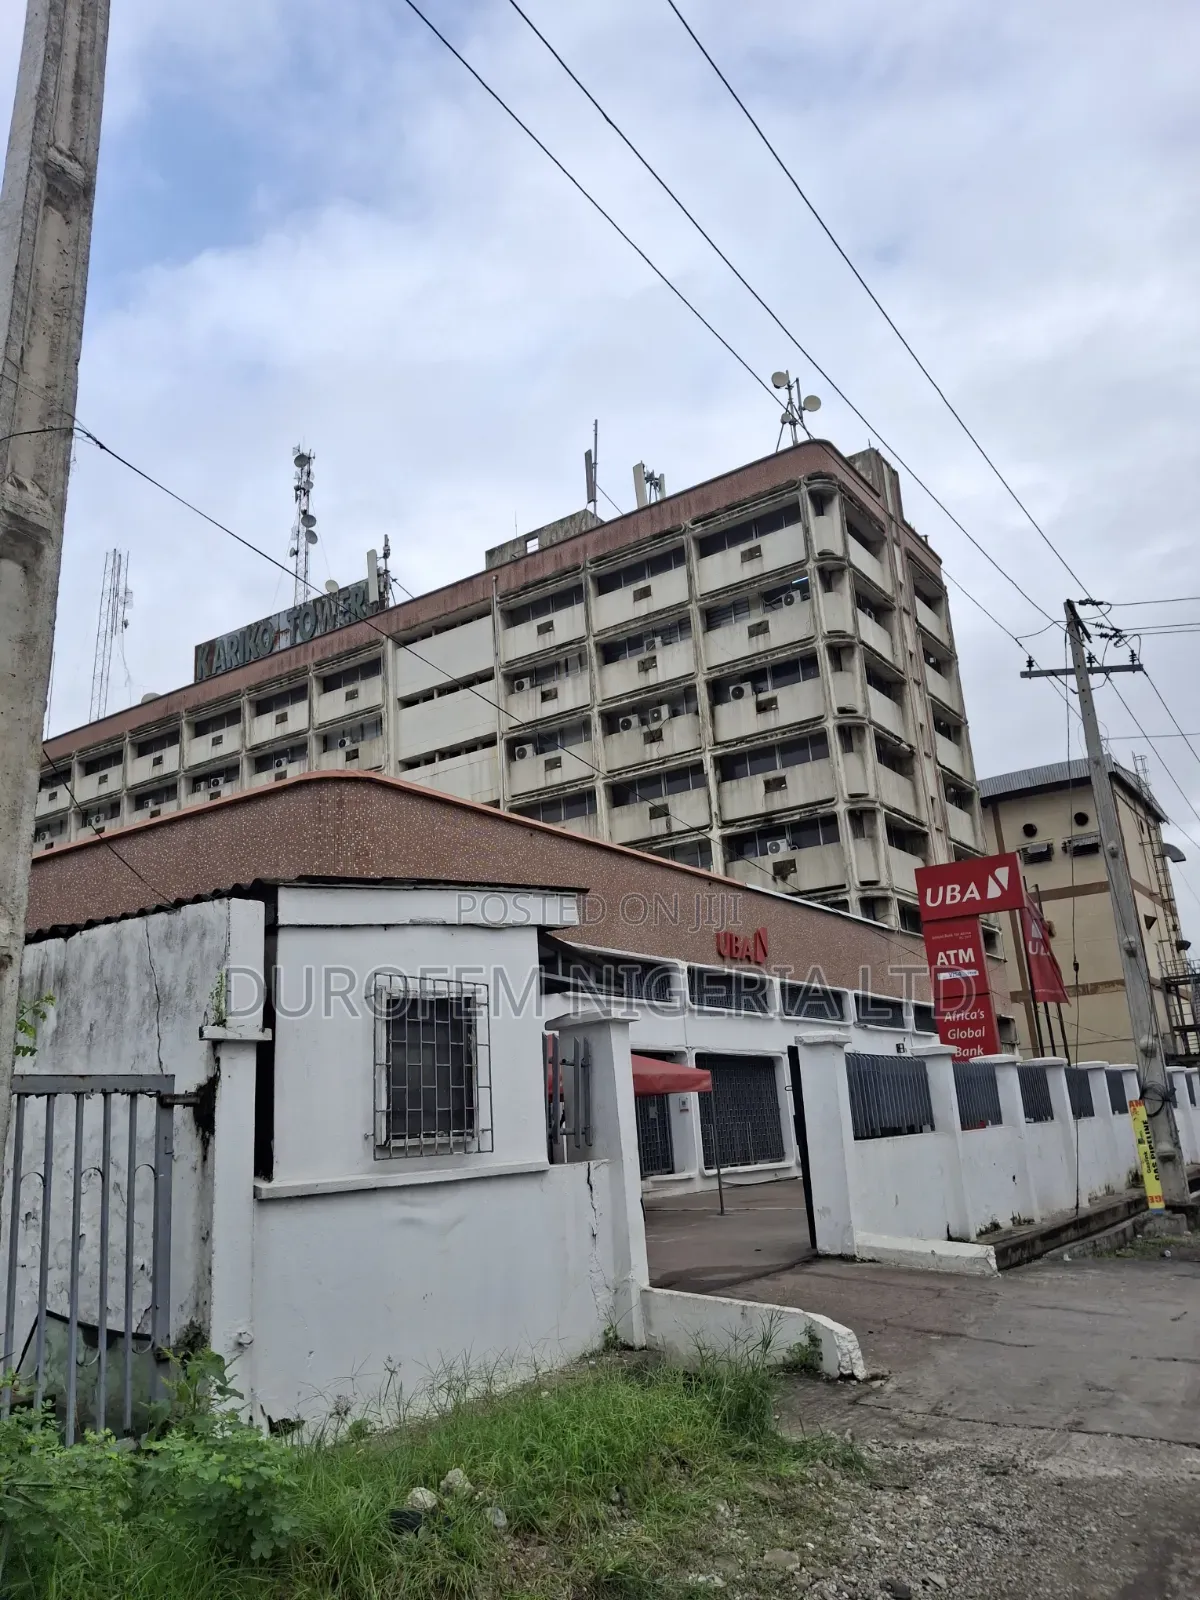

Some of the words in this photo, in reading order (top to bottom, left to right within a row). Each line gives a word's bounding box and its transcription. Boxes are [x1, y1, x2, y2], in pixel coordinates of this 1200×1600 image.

[197, 621, 275, 680] KARIKO
[925, 882, 981, 907] UBA
[716, 931, 755, 963] UBA
[936, 947, 976, 966] ATM
[944, 1008, 985, 1022] Africa's
[947, 1026, 985, 1040] Global
[955, 1045, 984, 1057] Bank
